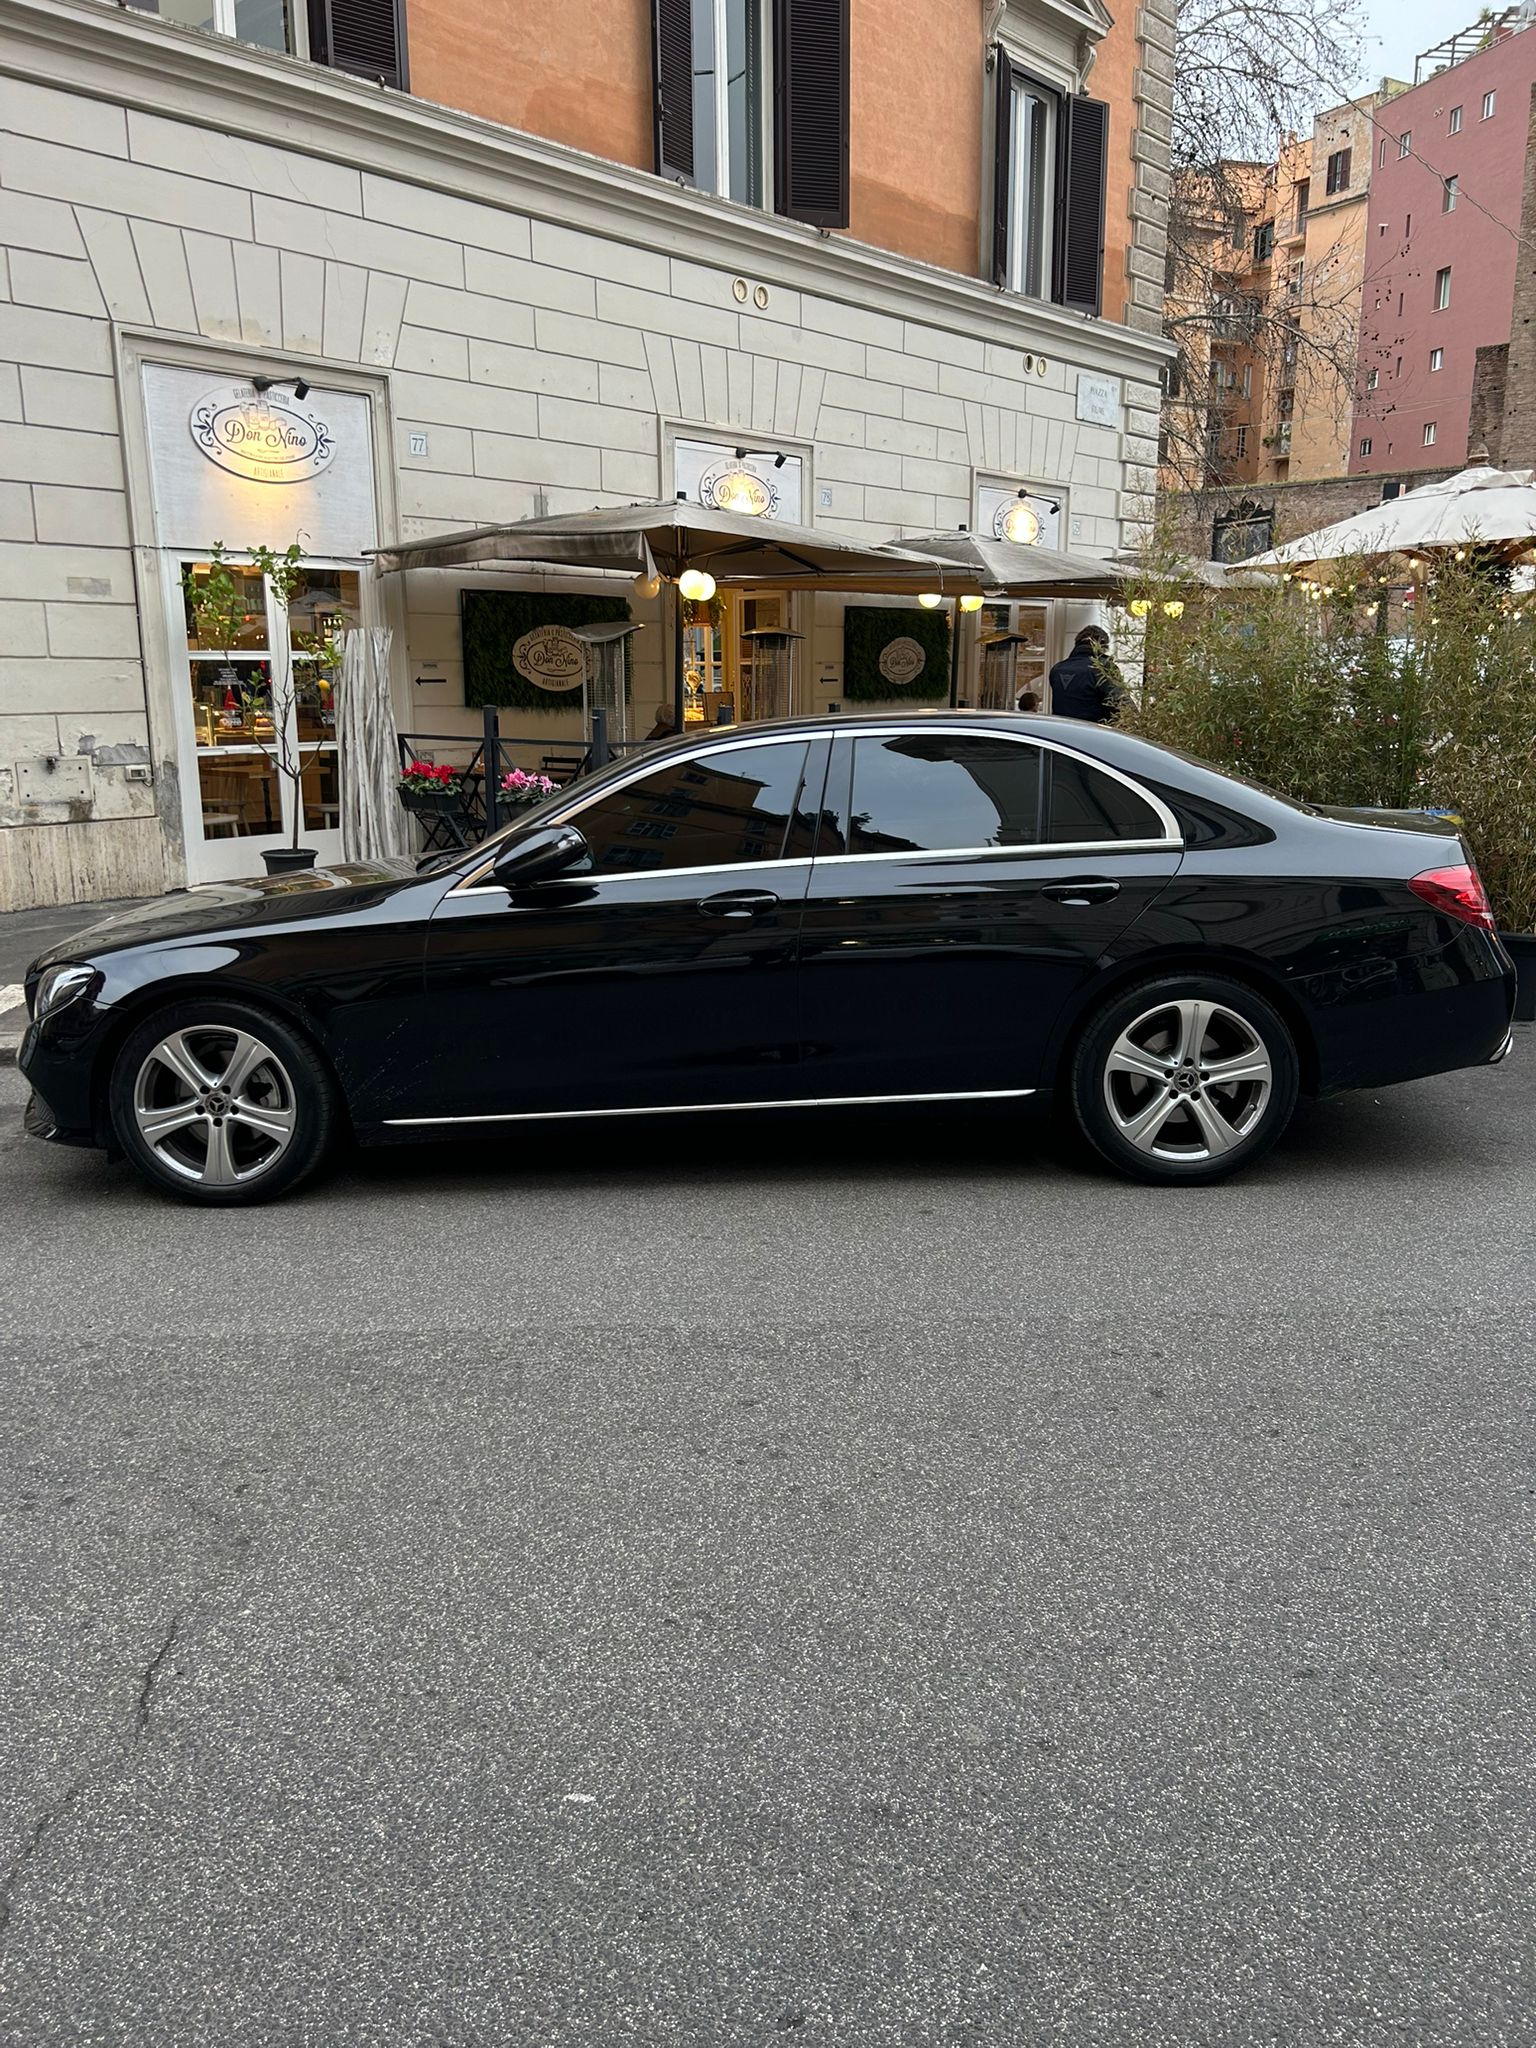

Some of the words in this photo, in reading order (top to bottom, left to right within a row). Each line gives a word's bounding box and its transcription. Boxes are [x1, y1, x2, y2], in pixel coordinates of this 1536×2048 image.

[224, 420, 261, 443] Don
[265, 427, 306, 448] Nino
[412, 437, 424, 451] 77
[533, 650, 554, 667] Don
[556, 652, 579, 668] Nino
